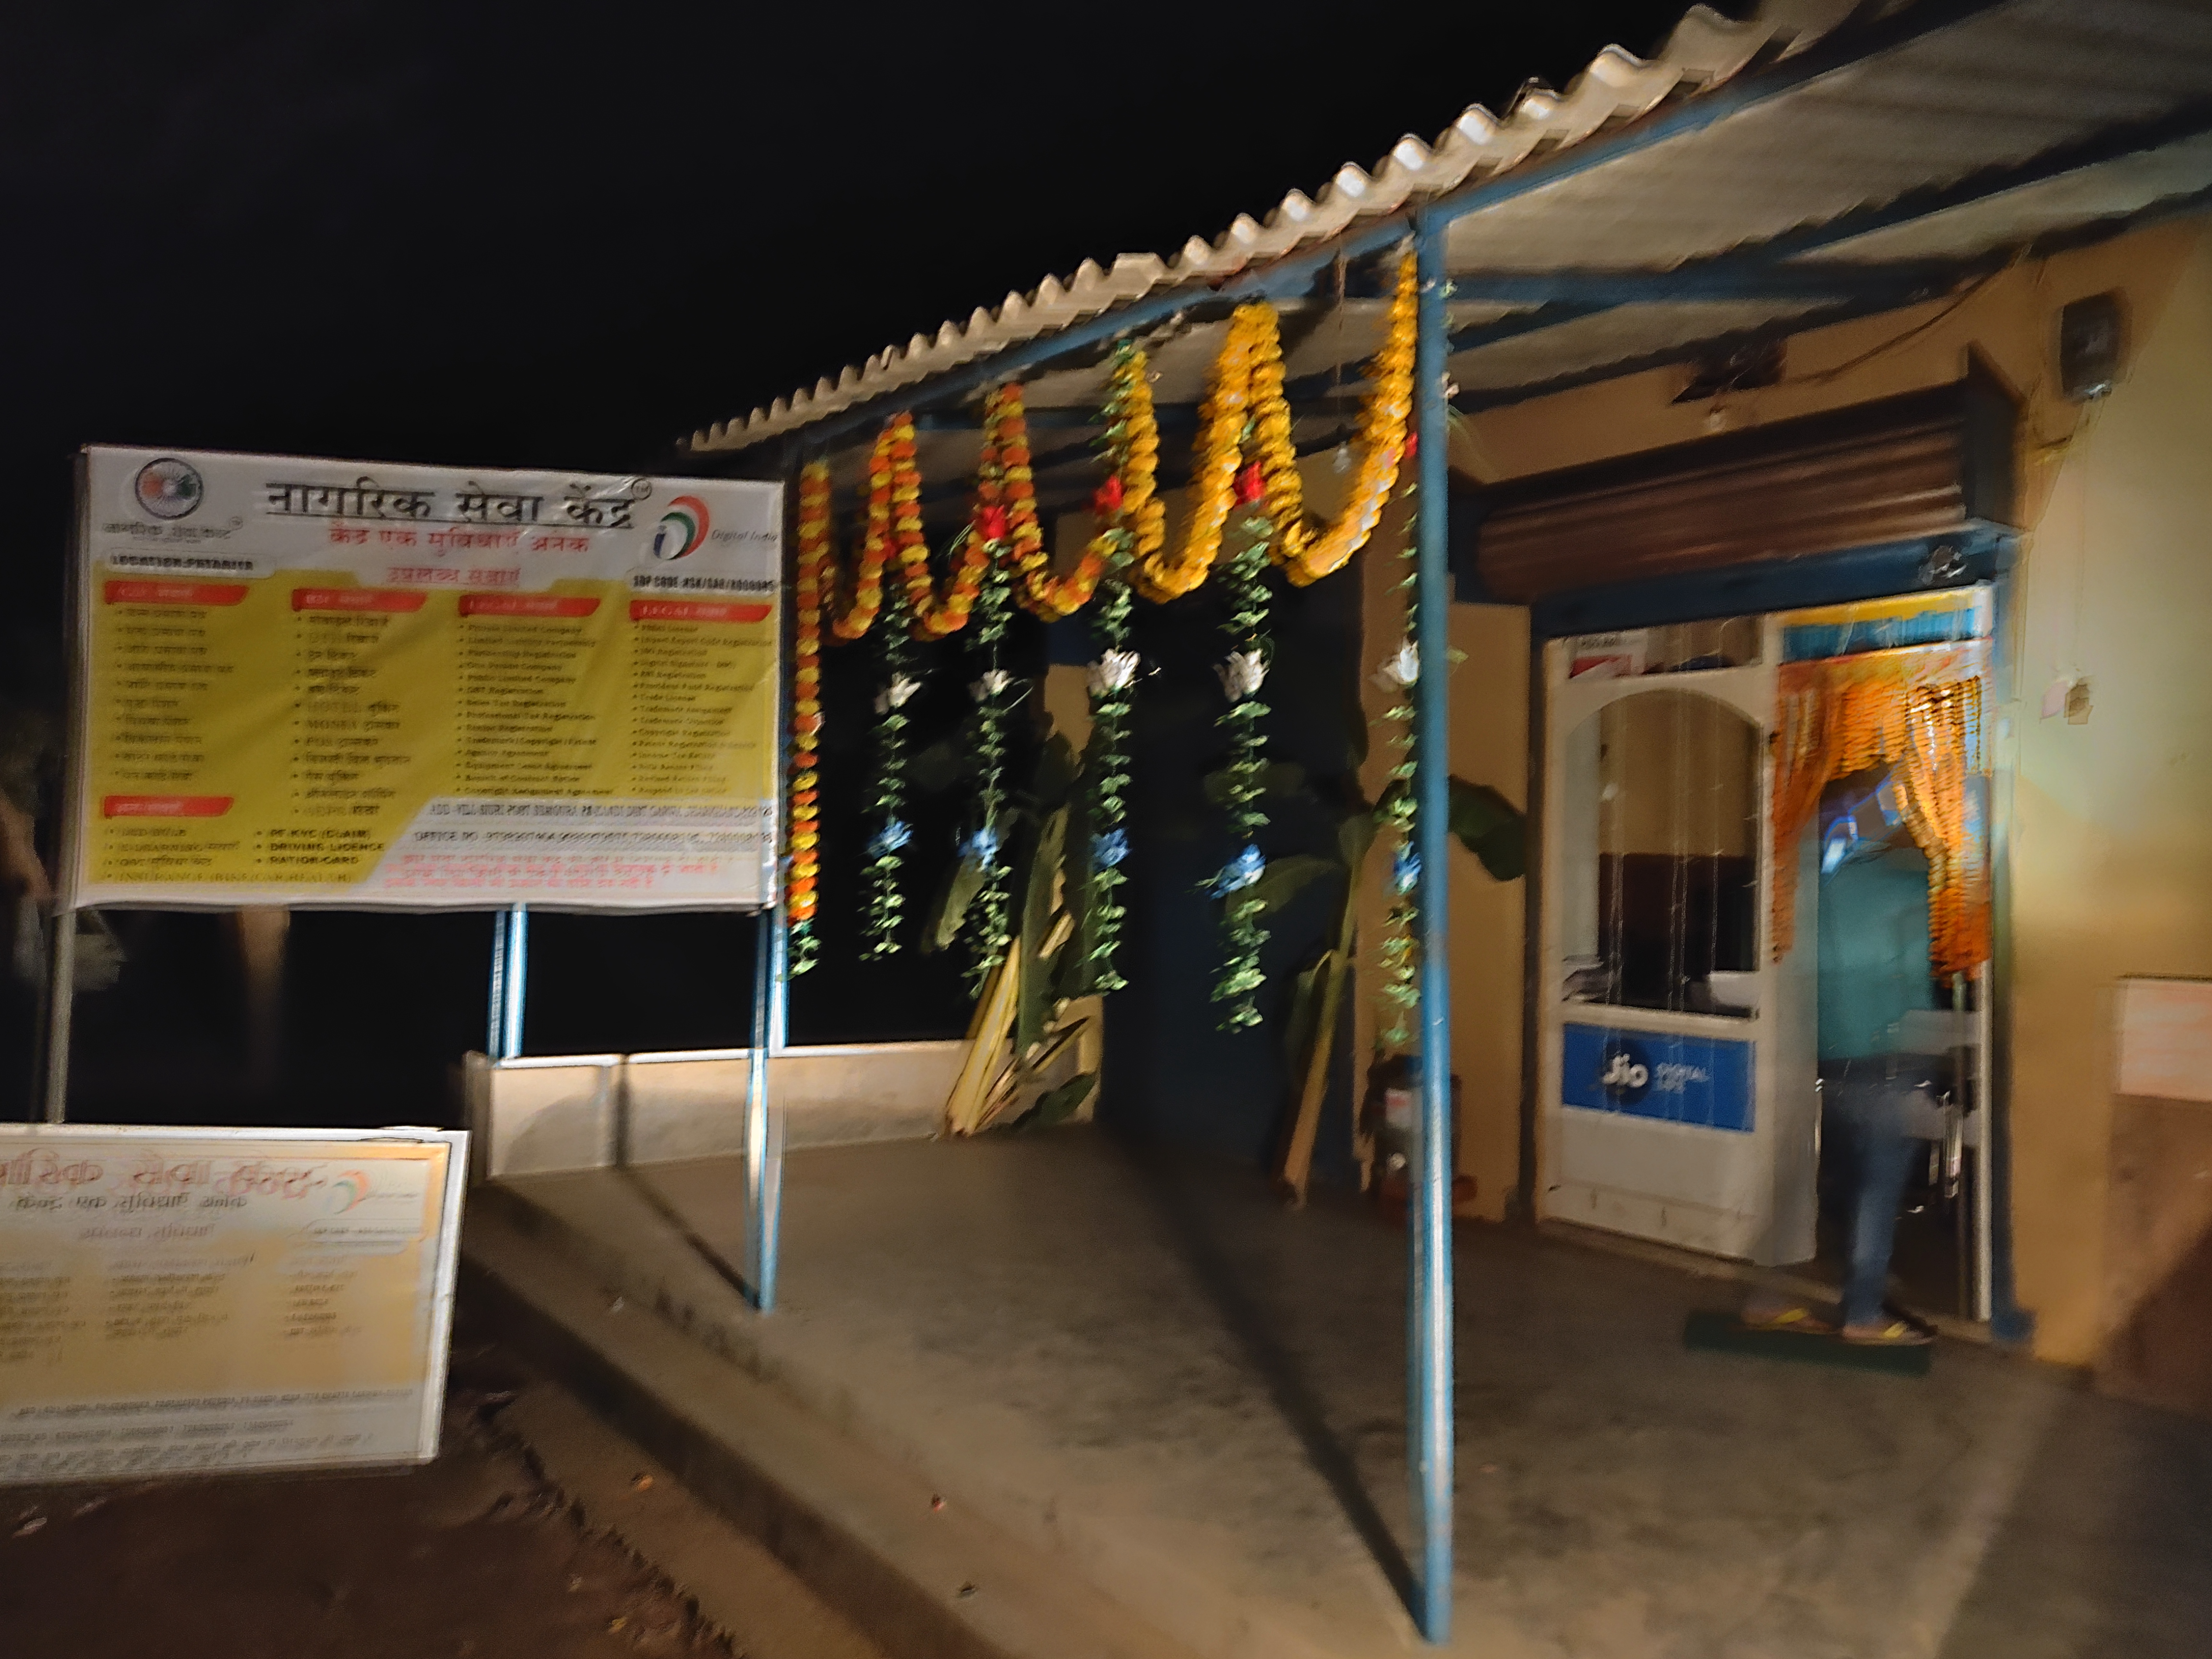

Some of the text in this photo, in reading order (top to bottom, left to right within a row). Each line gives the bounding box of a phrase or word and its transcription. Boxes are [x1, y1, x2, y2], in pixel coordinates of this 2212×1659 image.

[266, 476, 435, 518] नागरिक
[455, 481, 543, 522] सेवा
[711, 529, 779, 546] Digital India
[270, 842, 325, 852] DRIVING
[1601, 1053, 1649, 1088] Jio
